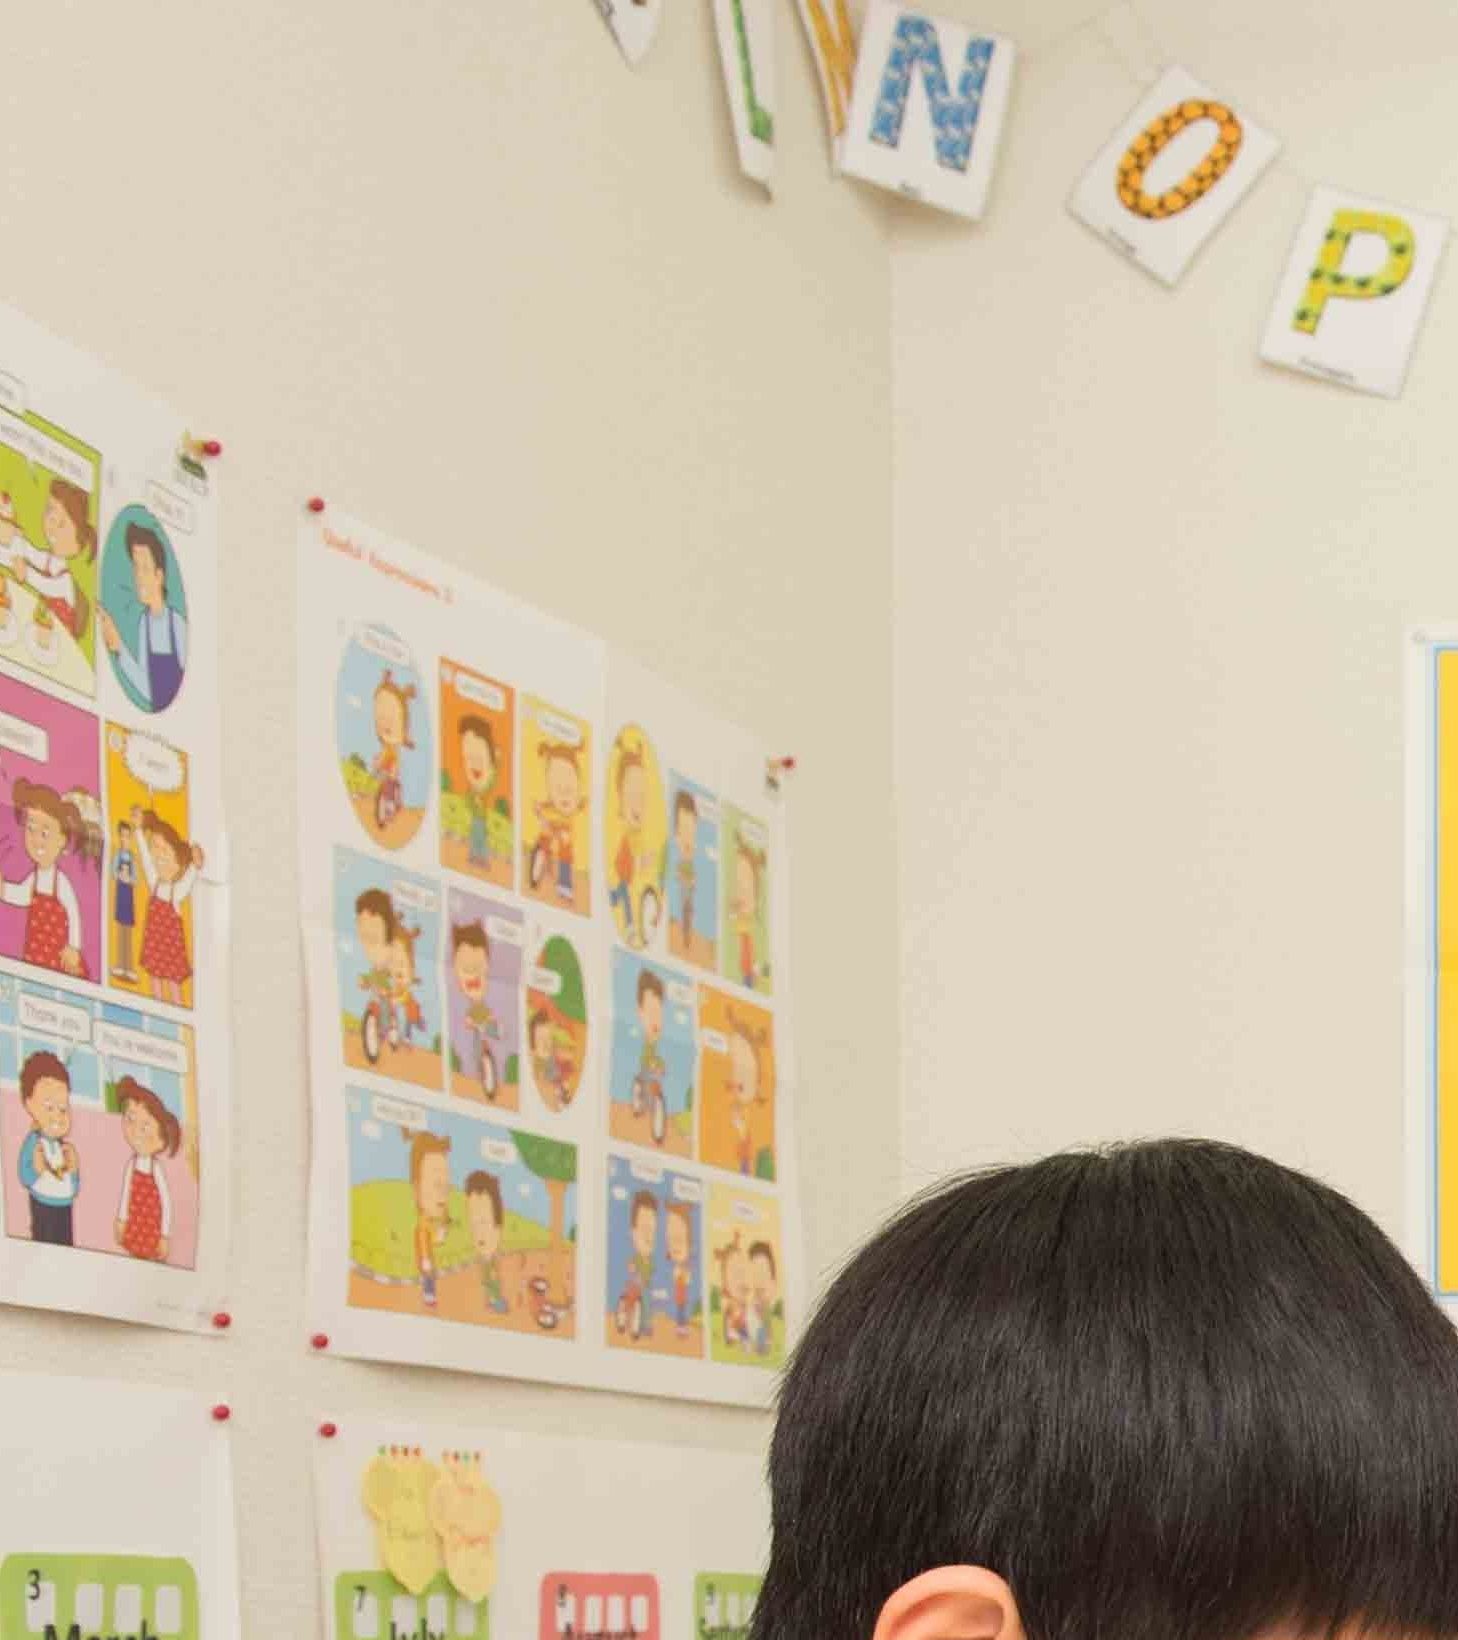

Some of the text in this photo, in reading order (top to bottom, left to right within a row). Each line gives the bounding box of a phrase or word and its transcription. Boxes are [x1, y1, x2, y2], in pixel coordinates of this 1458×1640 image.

[869, 15, 996, 173] N
[1115, 98, 1243, 220] O
[1291, 208, 1416, 335] P
[27, 1569, 41, 1601] 3
[353, 1585, 367, 1611] 7
